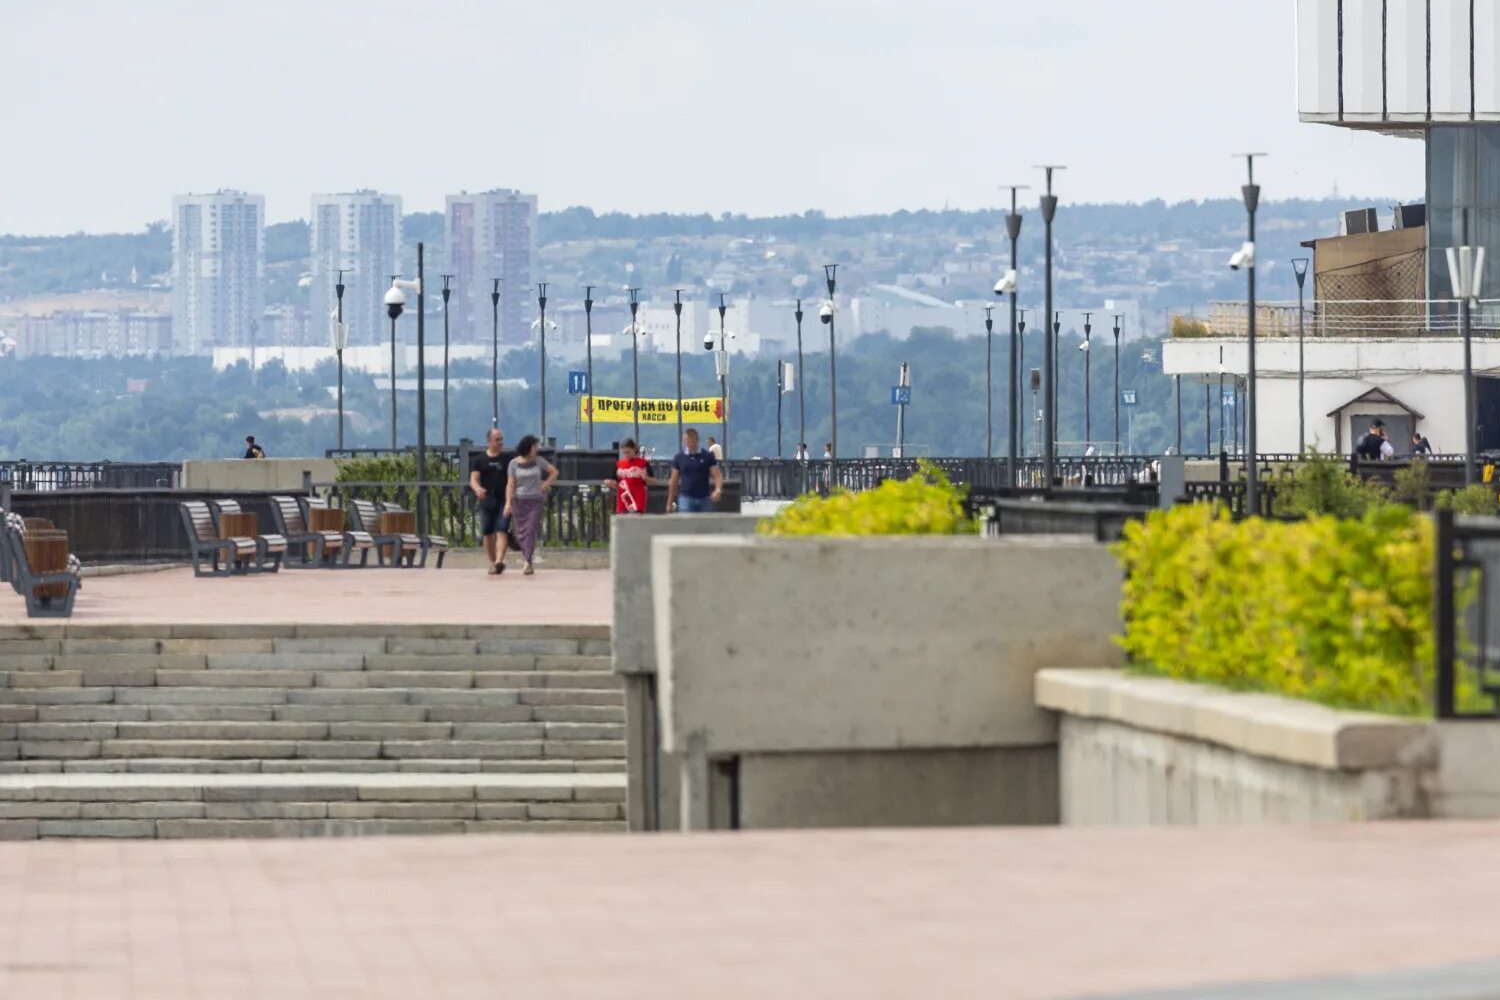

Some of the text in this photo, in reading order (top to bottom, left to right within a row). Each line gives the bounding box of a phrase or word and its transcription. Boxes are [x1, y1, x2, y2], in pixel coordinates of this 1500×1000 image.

[574, 374, 586, 391] 11
[598, 399, 655, 411] ПРОГУКИ
[658, 400, 673, 412] ПО
[642, 413, 667, 421] КАССА
